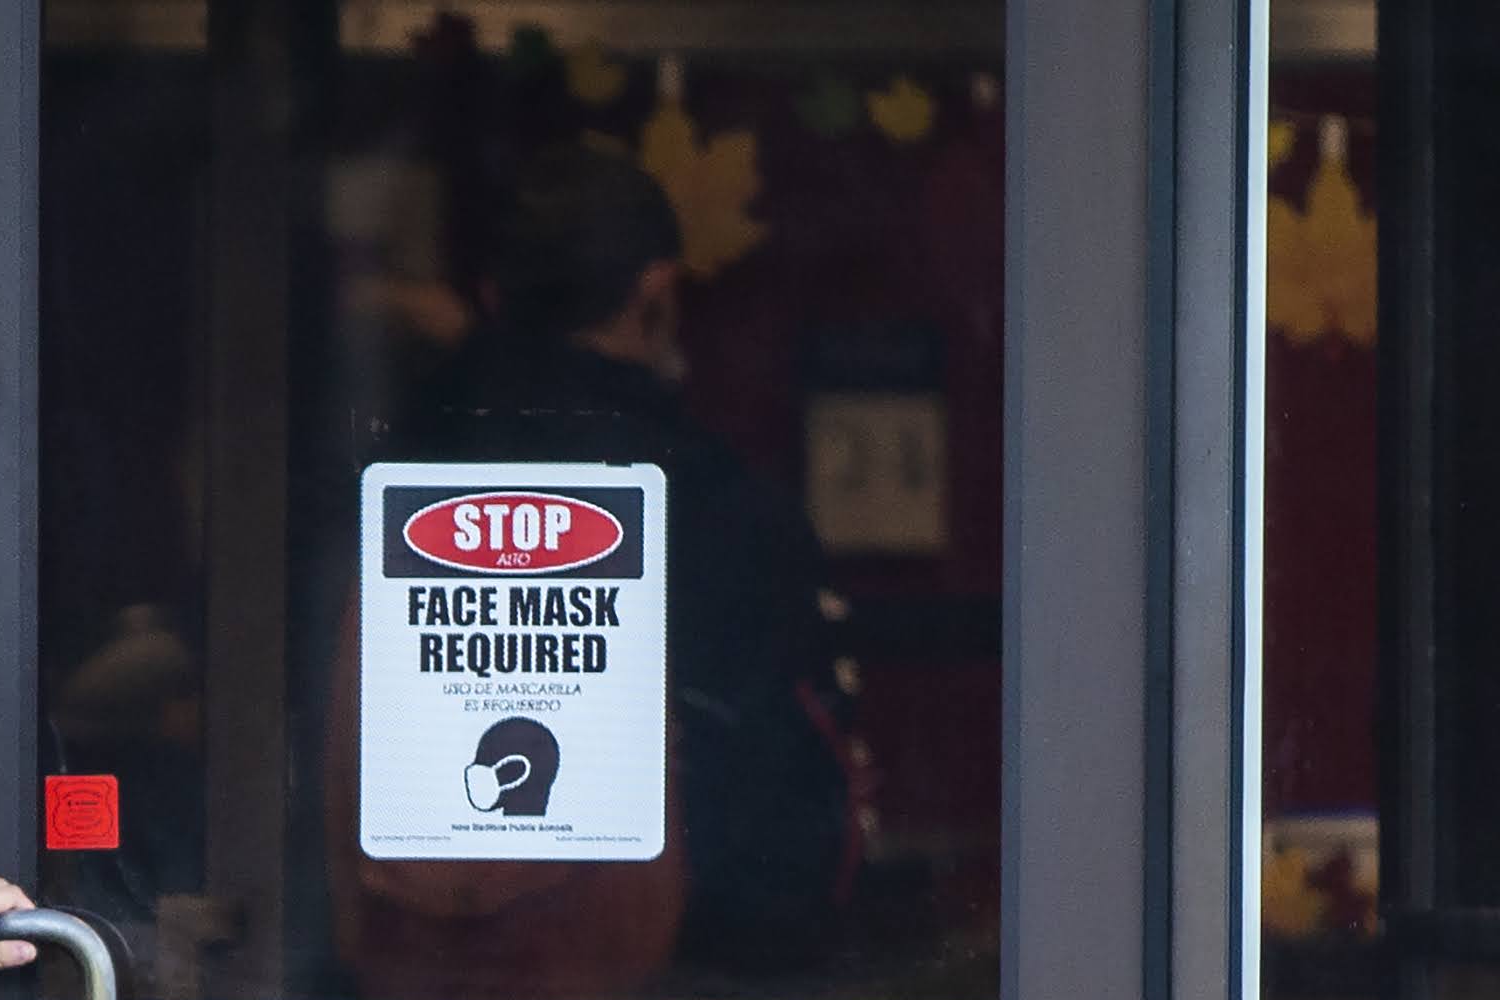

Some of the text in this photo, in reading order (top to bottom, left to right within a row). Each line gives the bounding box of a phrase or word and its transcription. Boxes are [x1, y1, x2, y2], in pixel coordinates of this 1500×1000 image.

[453, 503, 572, 551] STOP
[495, 552, 532, 567] ALTO
[408, 585, 620, 627] FACE MASK
[420, 632, 607, 678] REQUIRED
[443, 683, 582, 697] USO DE MASCARILLA
[464, 699, 561, 713] ES REQUERIDO
